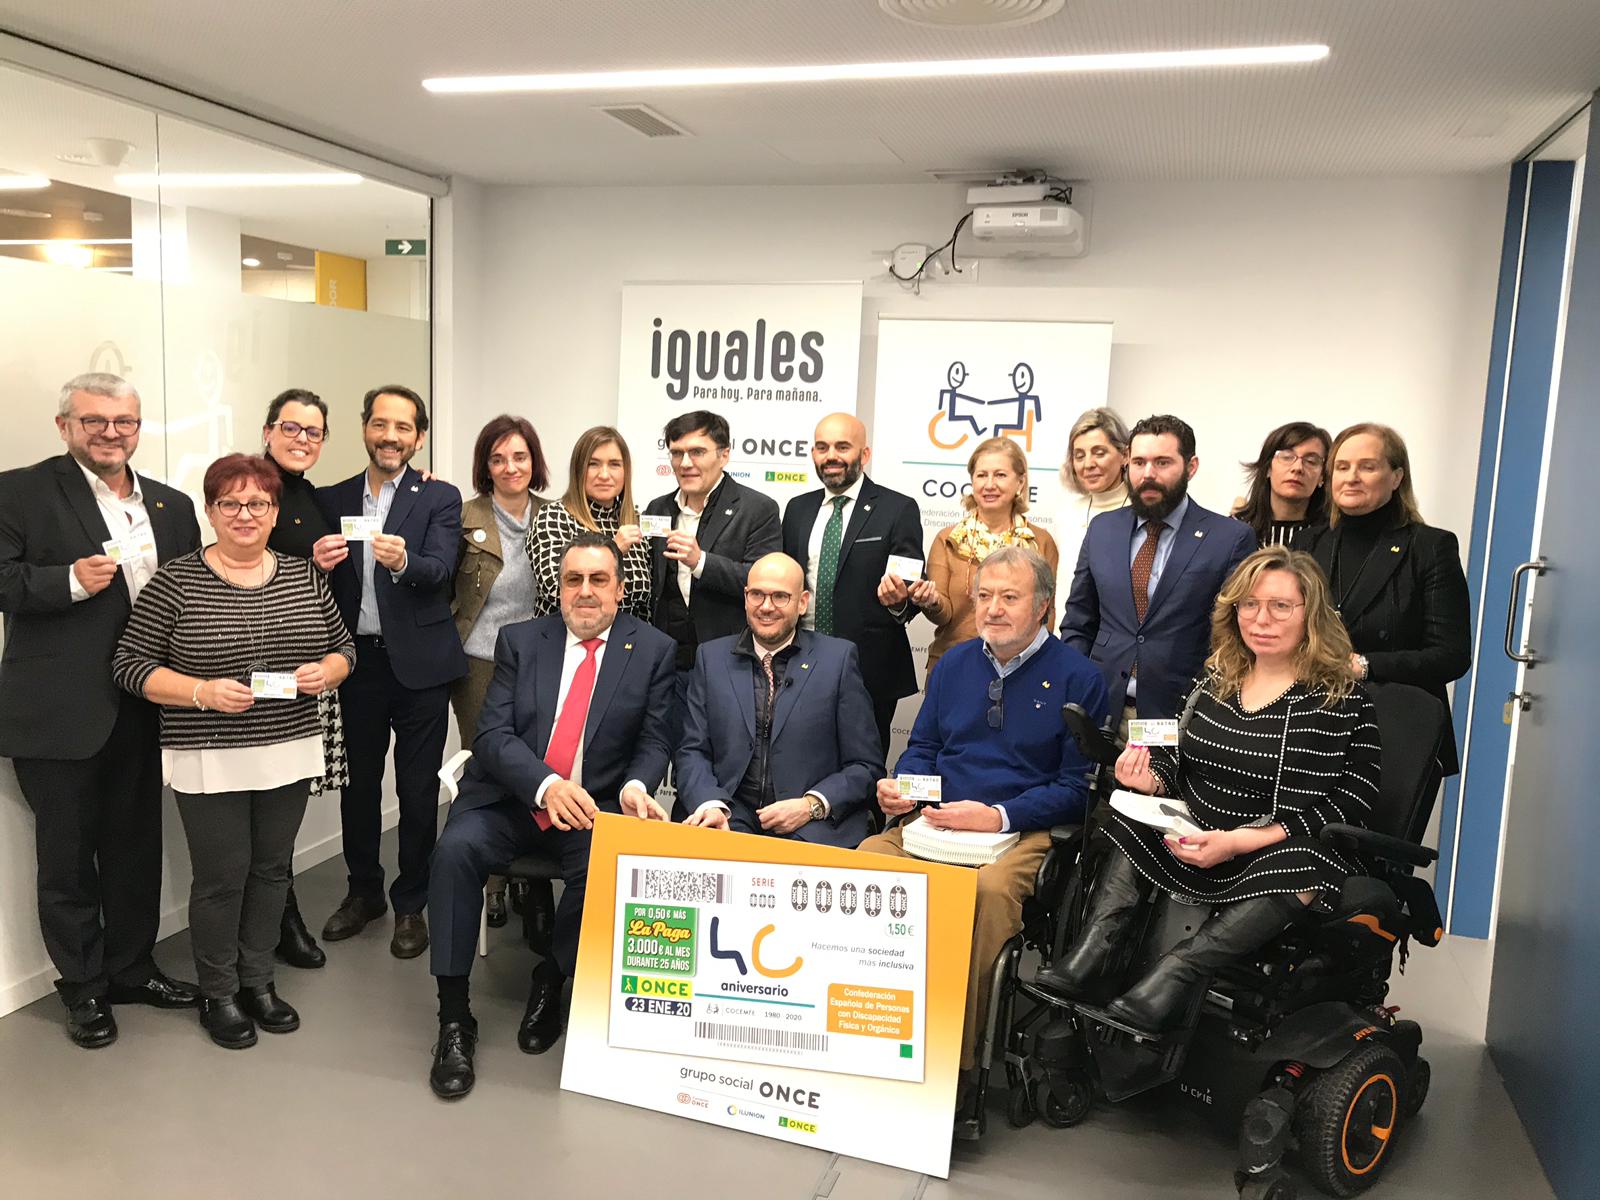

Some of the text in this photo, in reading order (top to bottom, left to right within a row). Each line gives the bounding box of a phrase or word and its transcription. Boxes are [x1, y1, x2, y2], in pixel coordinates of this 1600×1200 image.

[651, 317, 824, 401] iguales
[693, 386, 822, 403] Para hoy. Para mañana.
[742, 438, 809, 457] ONCE
[777, 473, 806, 482] ONCE
[751, 877, 775, 888] SERIE
[634, 908, 646, 917] POR
[648, 908, 666, 920] 0,50
[628, 919, 692, 943] La Paga
[627, 938, 659, 955] 3.000
[665, 946, 674, 956] AL
[675, 947, 691, 958] MES
[811, 942, 905, 957] Hacemos una sociedad
[627, 956, 658, 968] DURANTE
[671, 958, 690, 970] AÑOS
[879, 959, 914, 970] inclusiva
[641, 980, 688, 996] ONCE
[721, 981, 789, 997] aniversario
[843, 988, 896, 1000] Confederación
[632, 998, 645, 1011] 23
[830, 997, 910, 1014] Española de Personas
[785, 1013, 802, 1021] 2020
[852, 1010, 902, 1023] Discapacidad
[680, 1067, 821, 1109] grupo social ONCE
[691, 1100, 709, 1109] ONCE
[739, 1108, 765, 1120] ILUNION
[789, 1120, 816, 1133] ONCE
